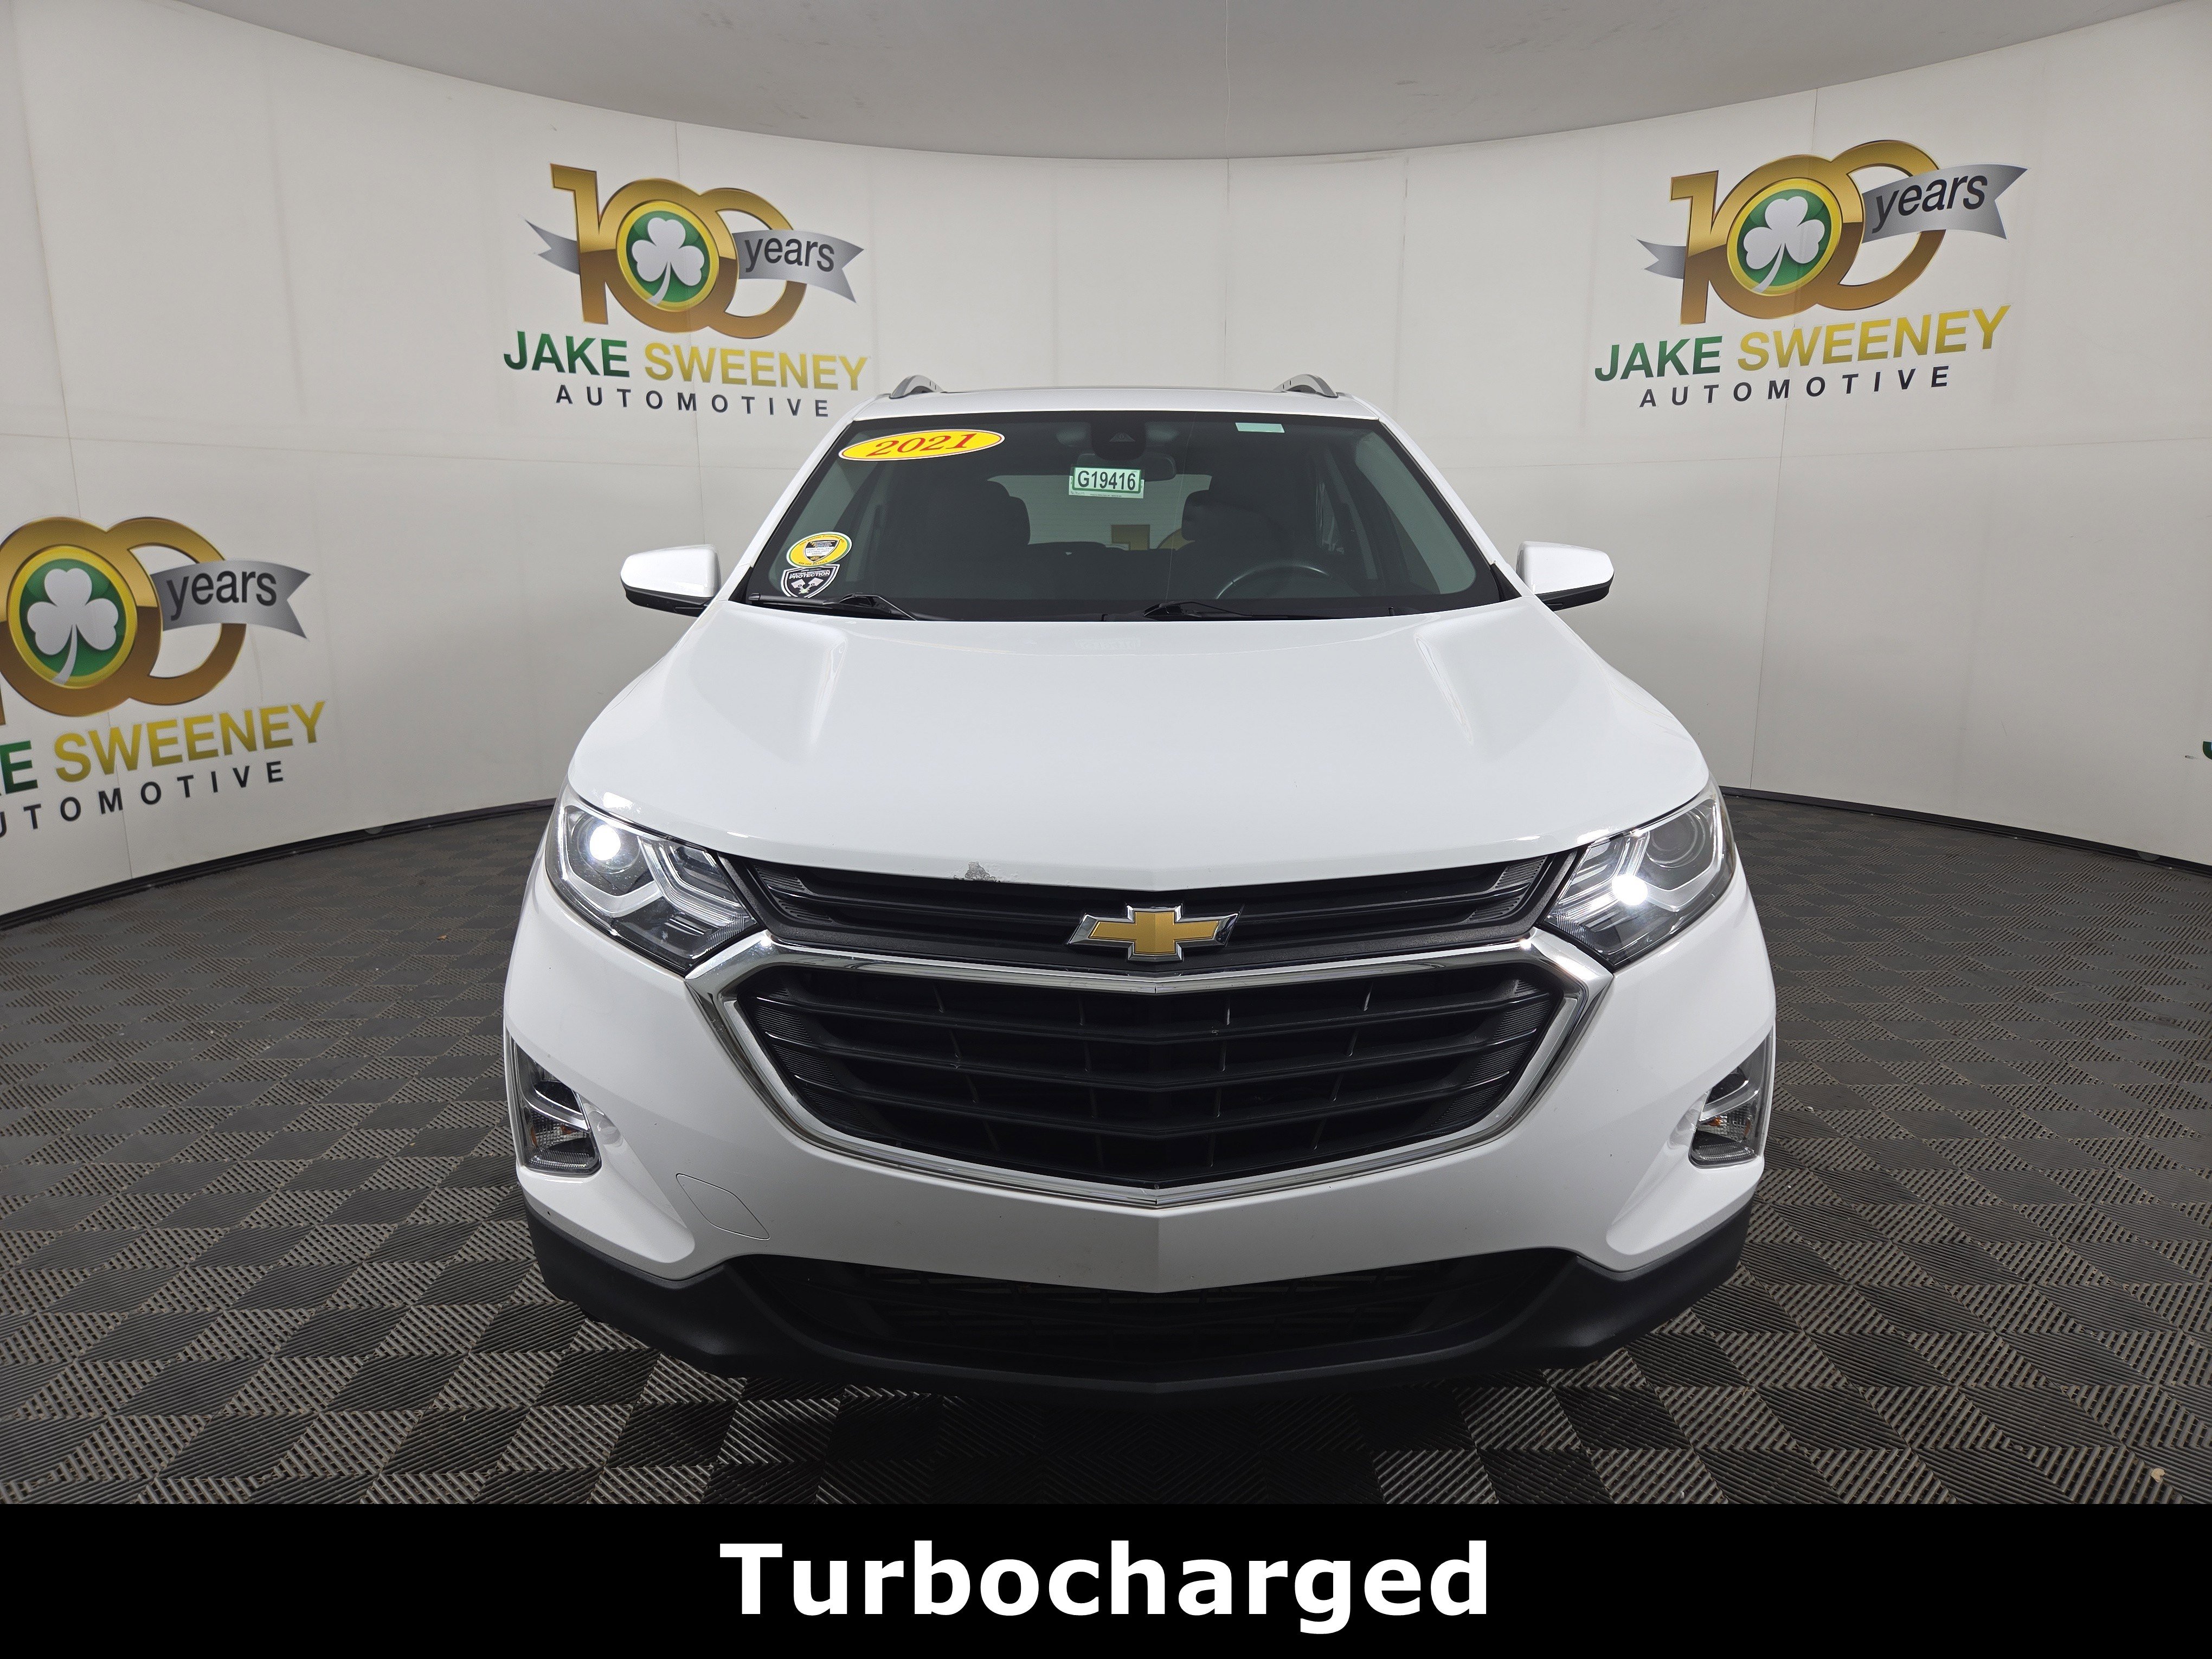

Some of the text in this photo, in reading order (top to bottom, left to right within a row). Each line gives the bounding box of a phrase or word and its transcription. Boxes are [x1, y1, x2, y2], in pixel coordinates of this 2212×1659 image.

[1669, 139, 1946, 325] 100
[1872, 175, 1988, 234] years
[550, 163, 807, 339] 100
[744, 237, 835, 273] years
[504, 330, 868, 391] JAKE SWEENEY
[1594, 305, 2011, 382] JAKE SWEENEY
[556, 384, 828, 417] AUTOMOTIVE
[1639, 365, 1949, 408] AUTOMOTIVE
[865, 433, 977, 458] 2021
[1077, 470, 1136, 491] G19416
[0, 517, 247, 726] 00
[166, 570, 278, 621] years
[54, 700, 326, 783] SWEENEY
